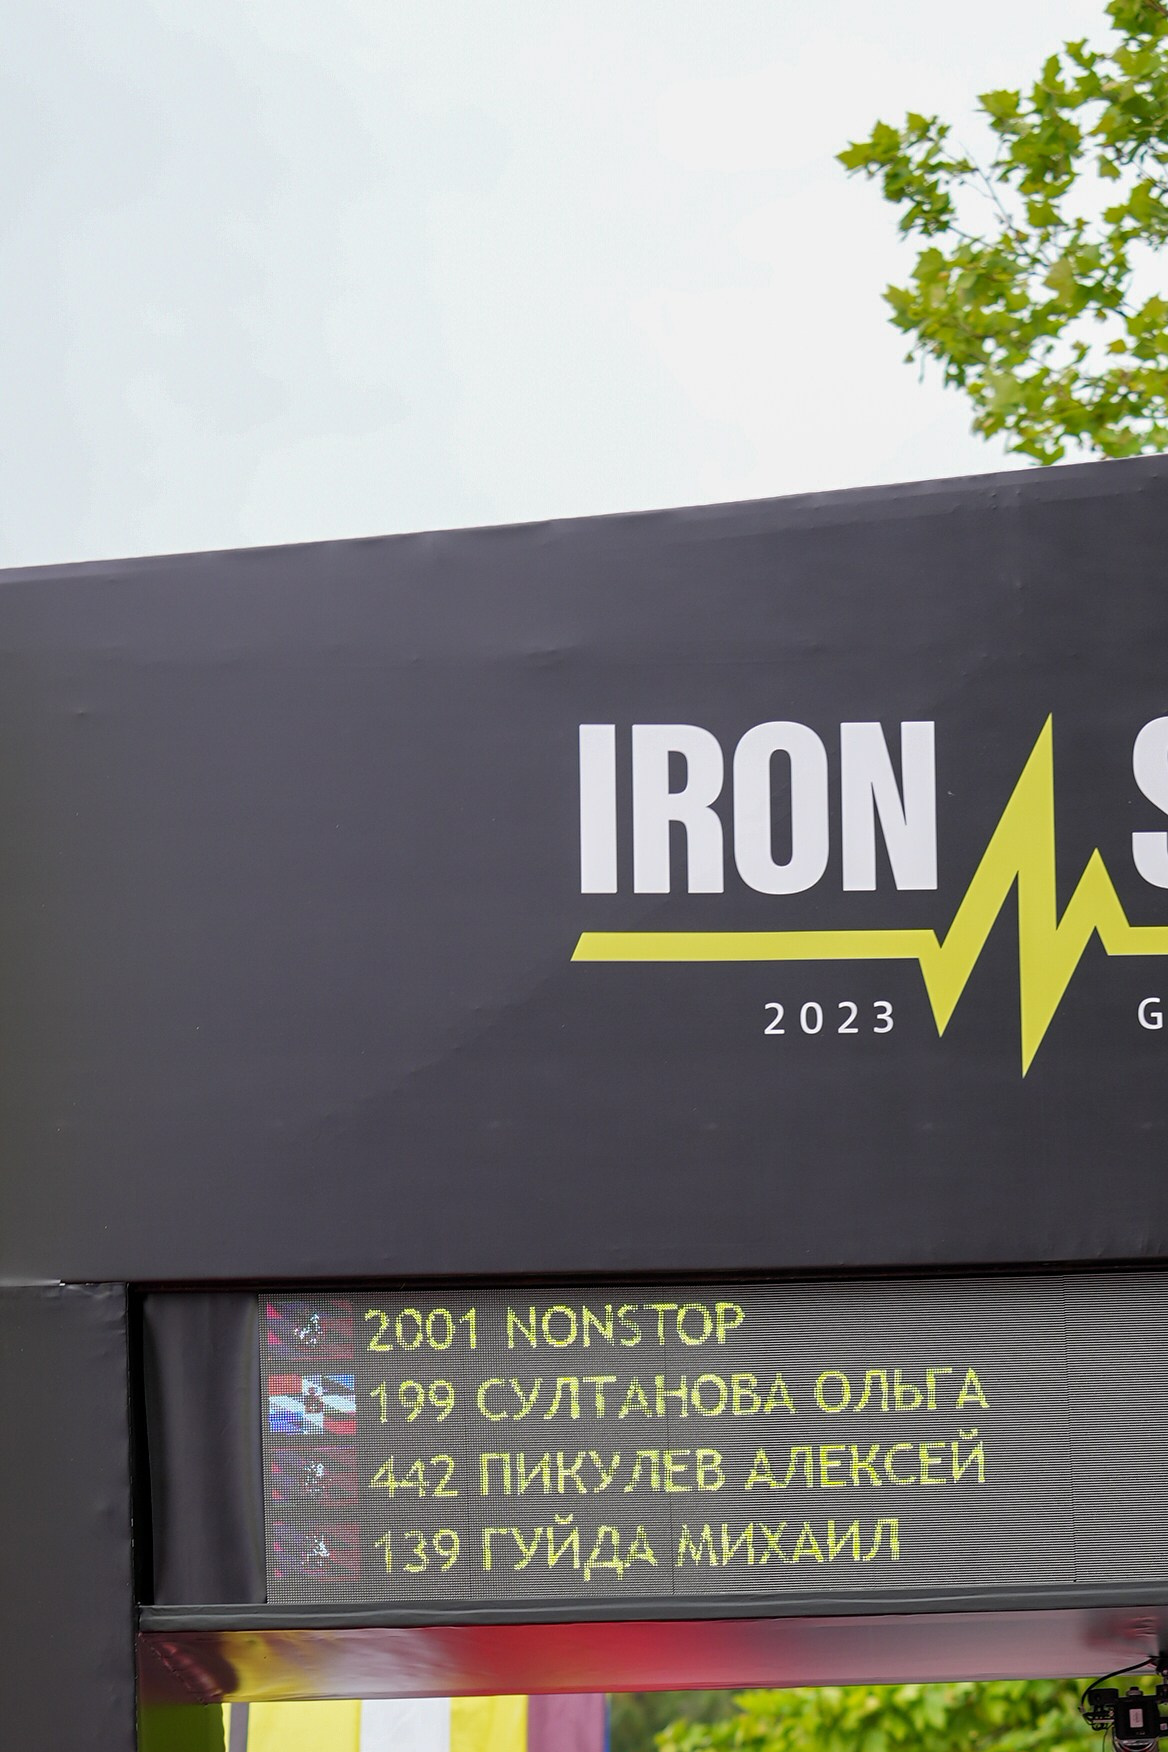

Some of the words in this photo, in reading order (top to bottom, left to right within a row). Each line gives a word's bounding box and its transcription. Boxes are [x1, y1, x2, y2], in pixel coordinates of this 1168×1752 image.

[578, 720, 938, 896] IRON
[763, 999, 896, 1036] 2023
[365, 1307, 478, 1353] 2001
[507, 1302, 745, 1348] NONSTOP
[369, 1380, 455, 1424] 199
[476, 1374, 796, 1421] СУЛТАНОВА
[814, 1367, 991, 1414] ОЛЬГА
[368, 1453, 460, 1498] 442
[479, 1447, 726, 1497] ПИКУЛЕВ
[744, 1427, 988, 1491] АЛЕКСЕЙ
[374, 1528, 461, 1574] 139
[482, 1513, 658, 1582] ГУЙДА
[675, 1517, 901, 1572] МИХАИЛ
